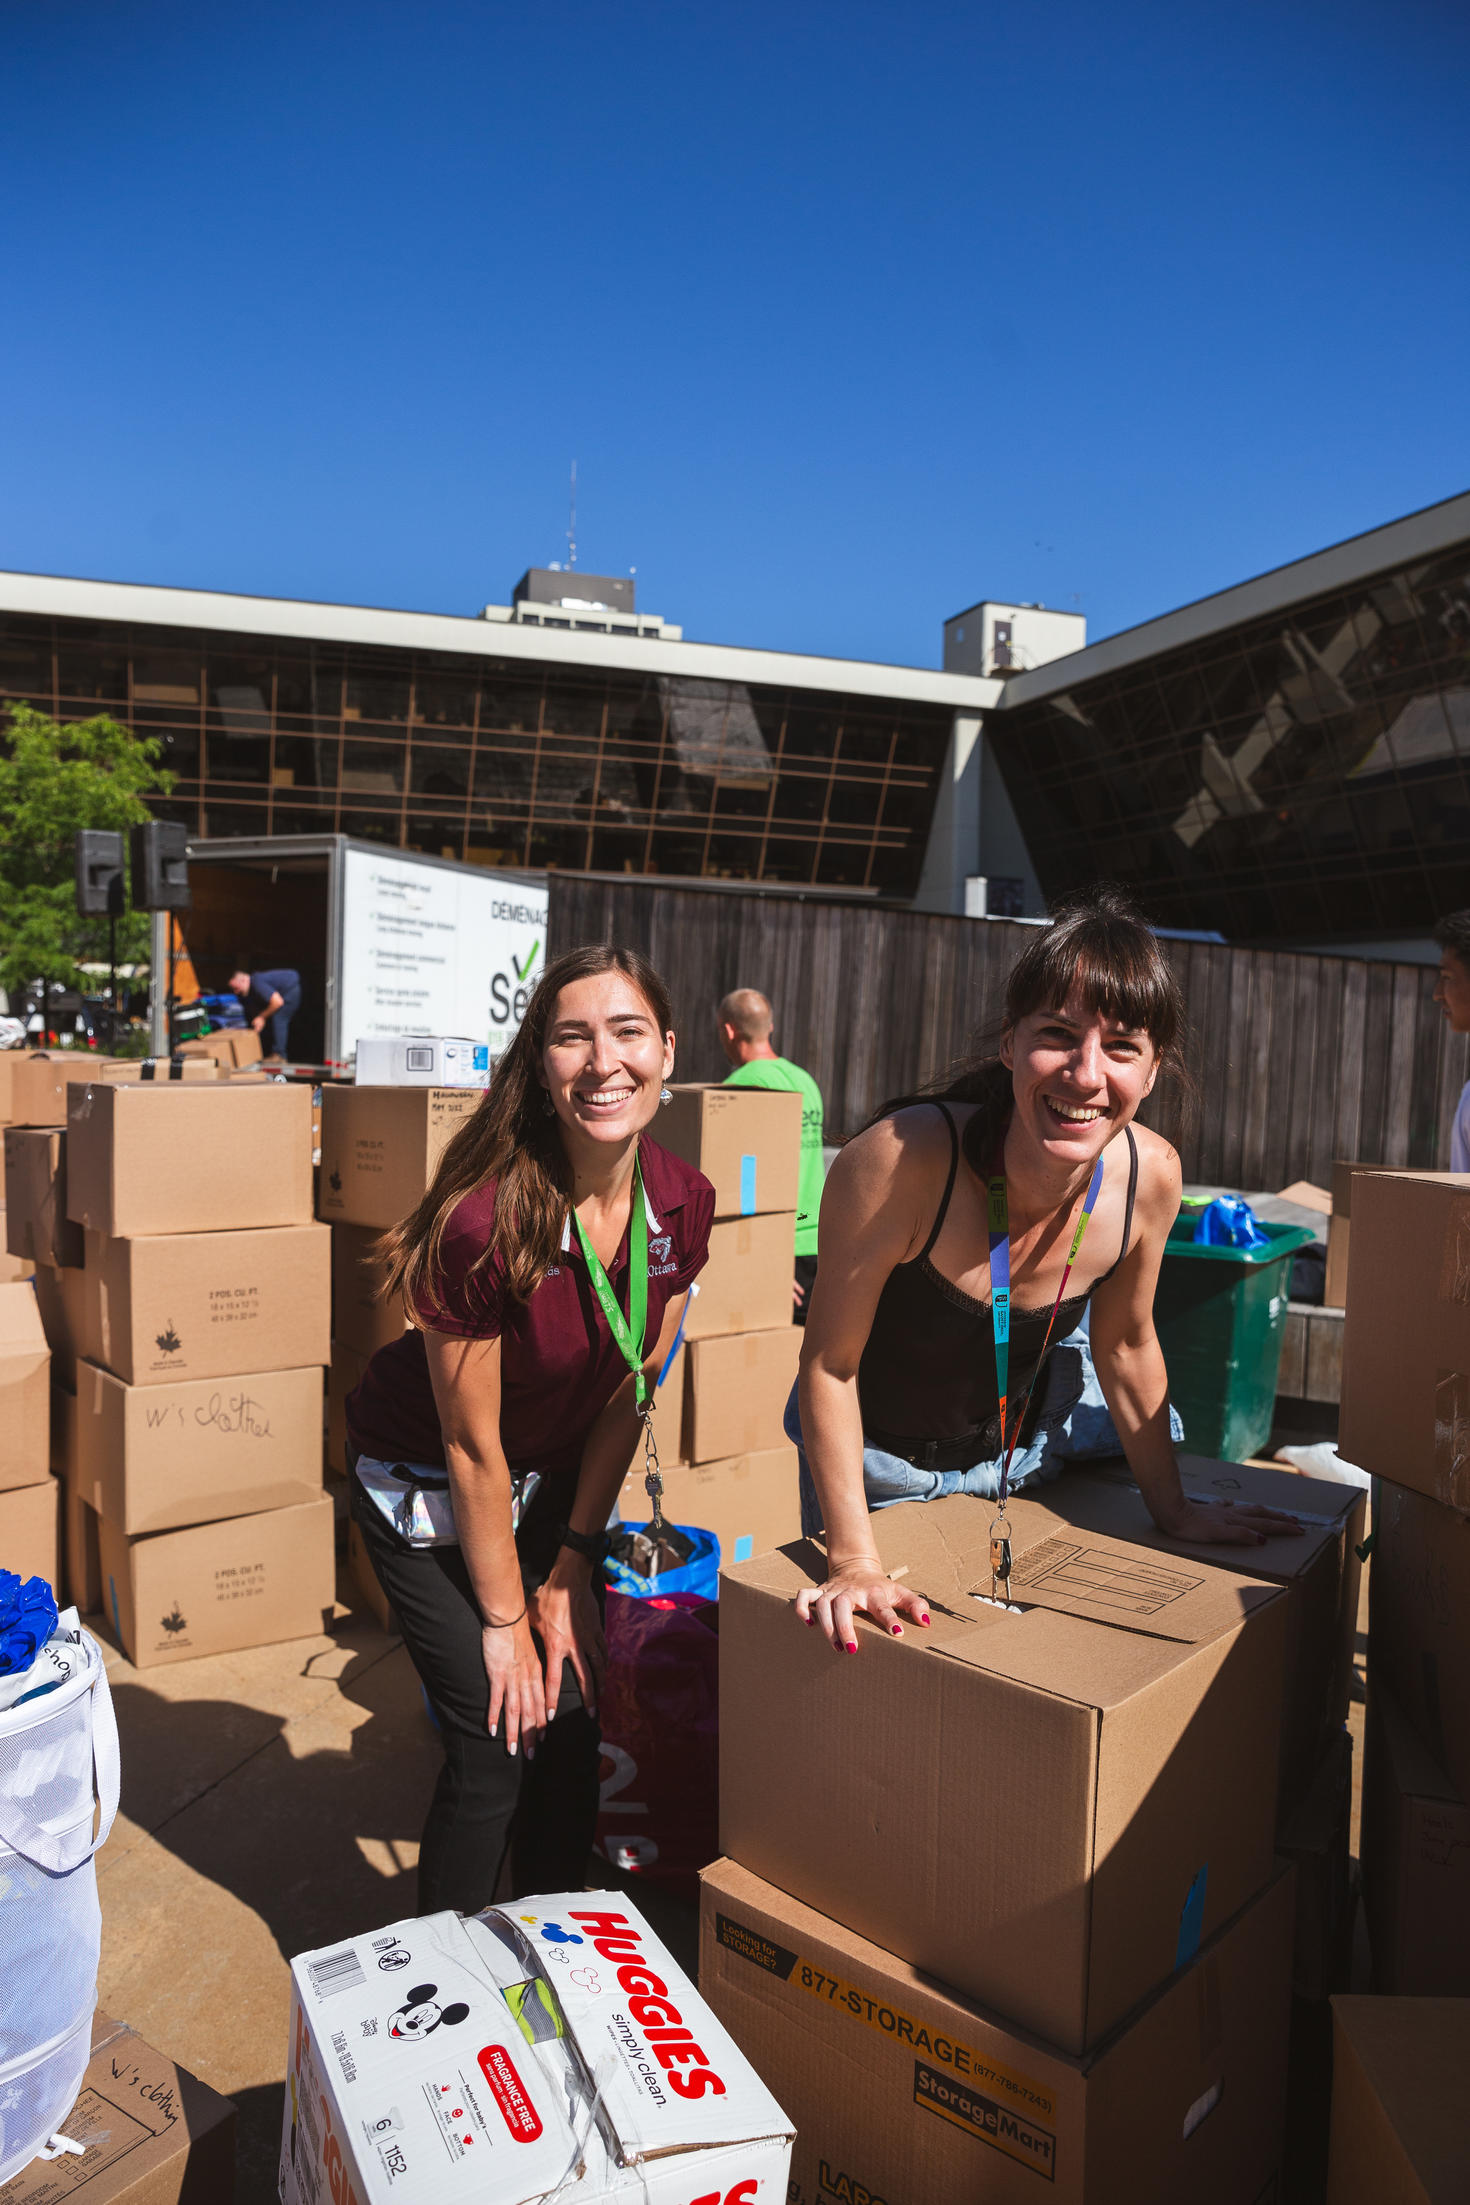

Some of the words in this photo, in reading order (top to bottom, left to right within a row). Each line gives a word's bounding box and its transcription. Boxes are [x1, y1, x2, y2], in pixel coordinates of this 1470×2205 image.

[647, 1262, 677, 1278] Ottawa
[723, 1920, 762, 1951] Looking
[763, 1942, 777, 1958] for
[723, 1932, 777, 1969] STORAGE?
[567, 1912, 726, 2099] HUGGIES
[360, 2019, 372, 2037] baby
[612, 2013, 645, 2060] simply
[801, 1965, 971, 2074] 877-STORAGE
[973, 2061, 1053, 2114] (877-786-7243)
[464, 2084, 477, 2104] Perfect
[489, 2051, 524, 2106] FRAGRANCE
[515, 2105, 536, 2132] FREE
[490, 2074, 503, 2094] parfum
[472, 2103, 480, 2112] for
[475, 2111, 487, 2129] baby's
[918, 2069, 1051, 2158] StorageMart
[376, 2118, 392, 2131] 6
[384, 2144, 407, 2177] 1152
